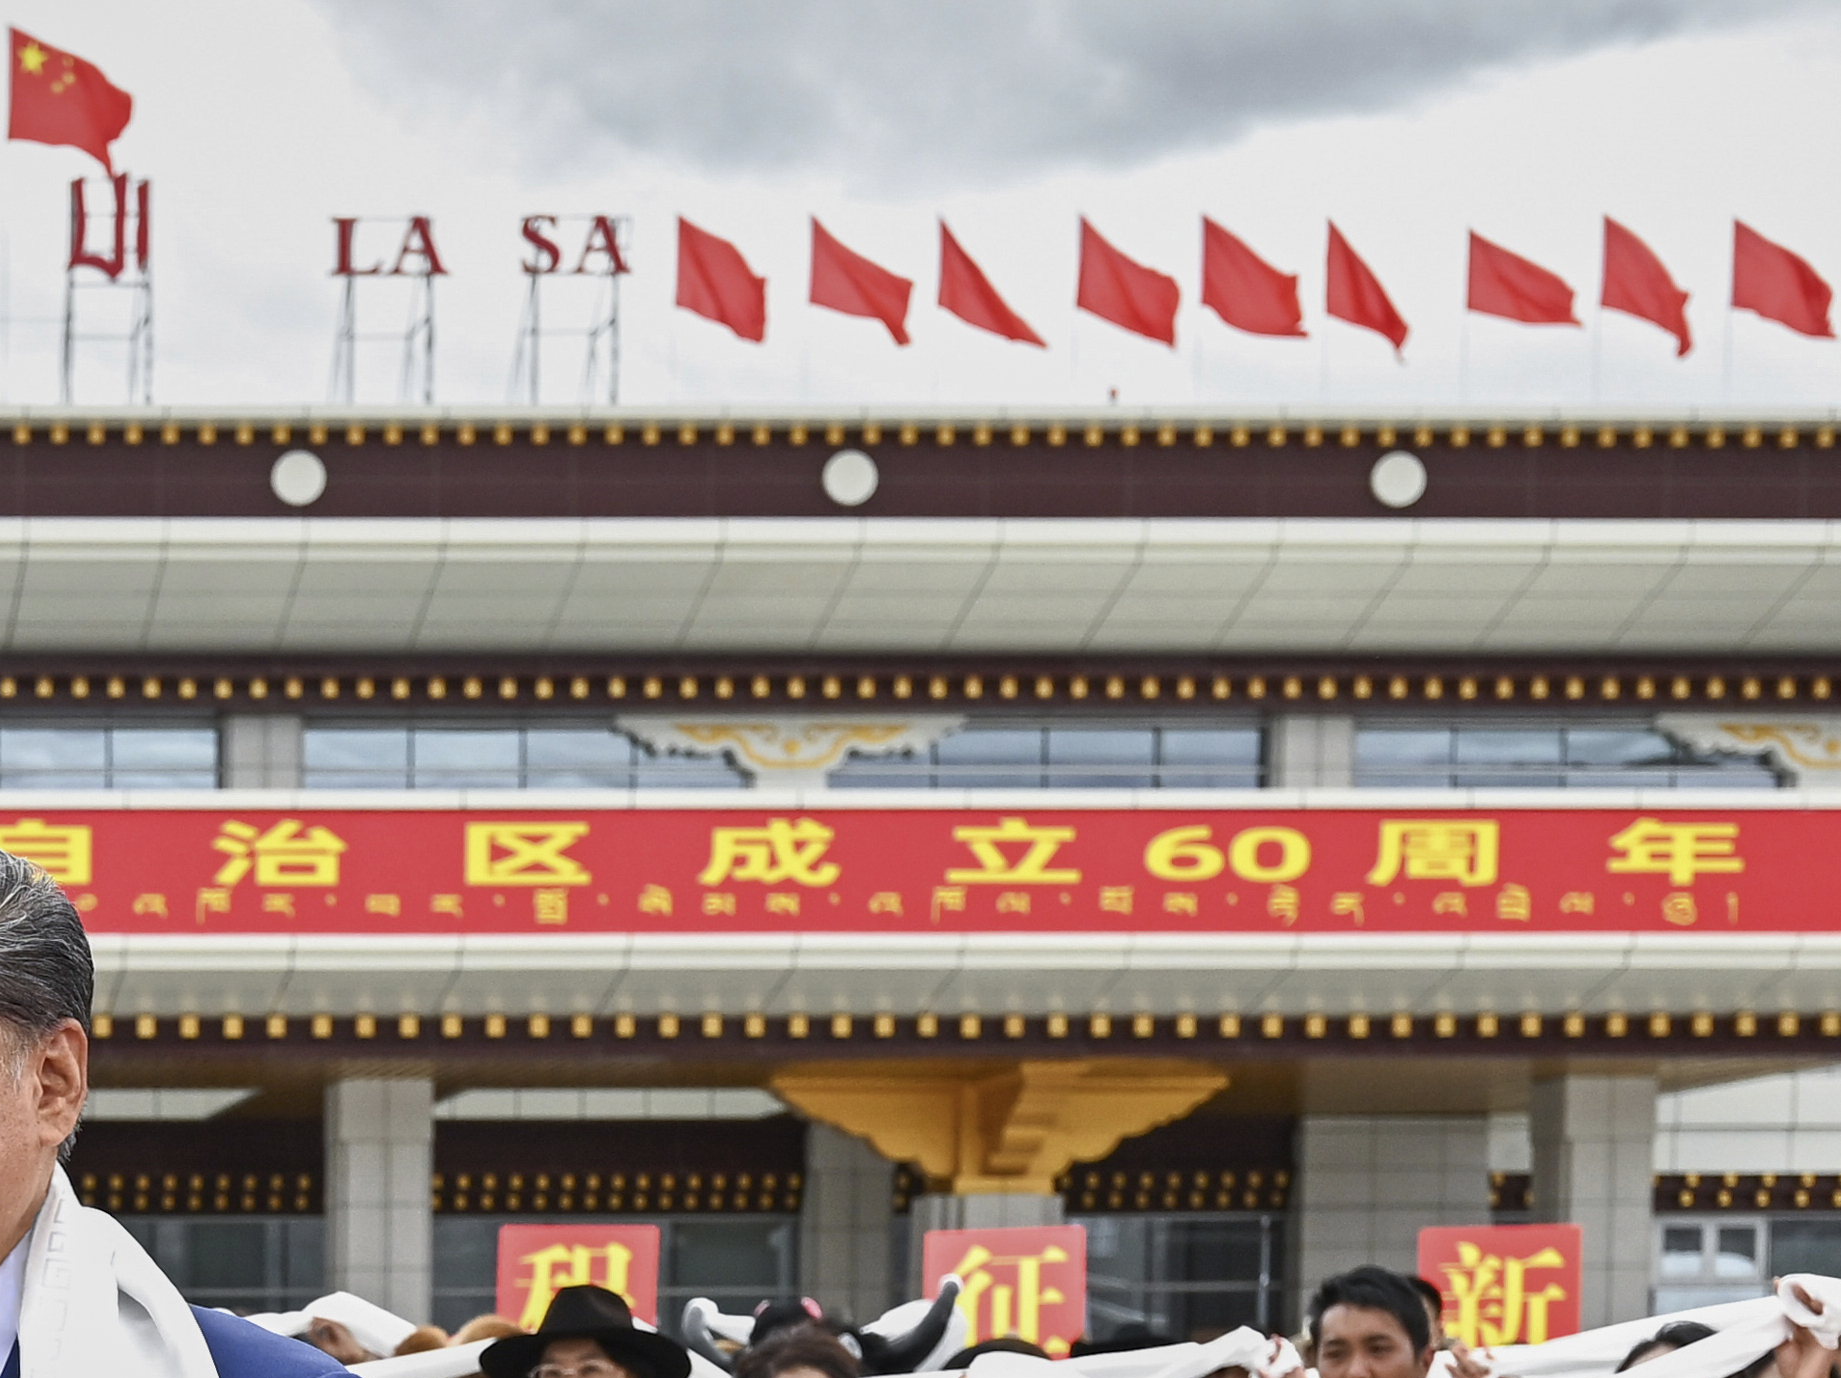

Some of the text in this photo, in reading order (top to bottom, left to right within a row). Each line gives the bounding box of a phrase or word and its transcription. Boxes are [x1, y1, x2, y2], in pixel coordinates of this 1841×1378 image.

[331, 215, 631, 276] LA SA
[953, 1245, 1071, 1354] 征
[1439, 1241, 1566, 1349] 新
